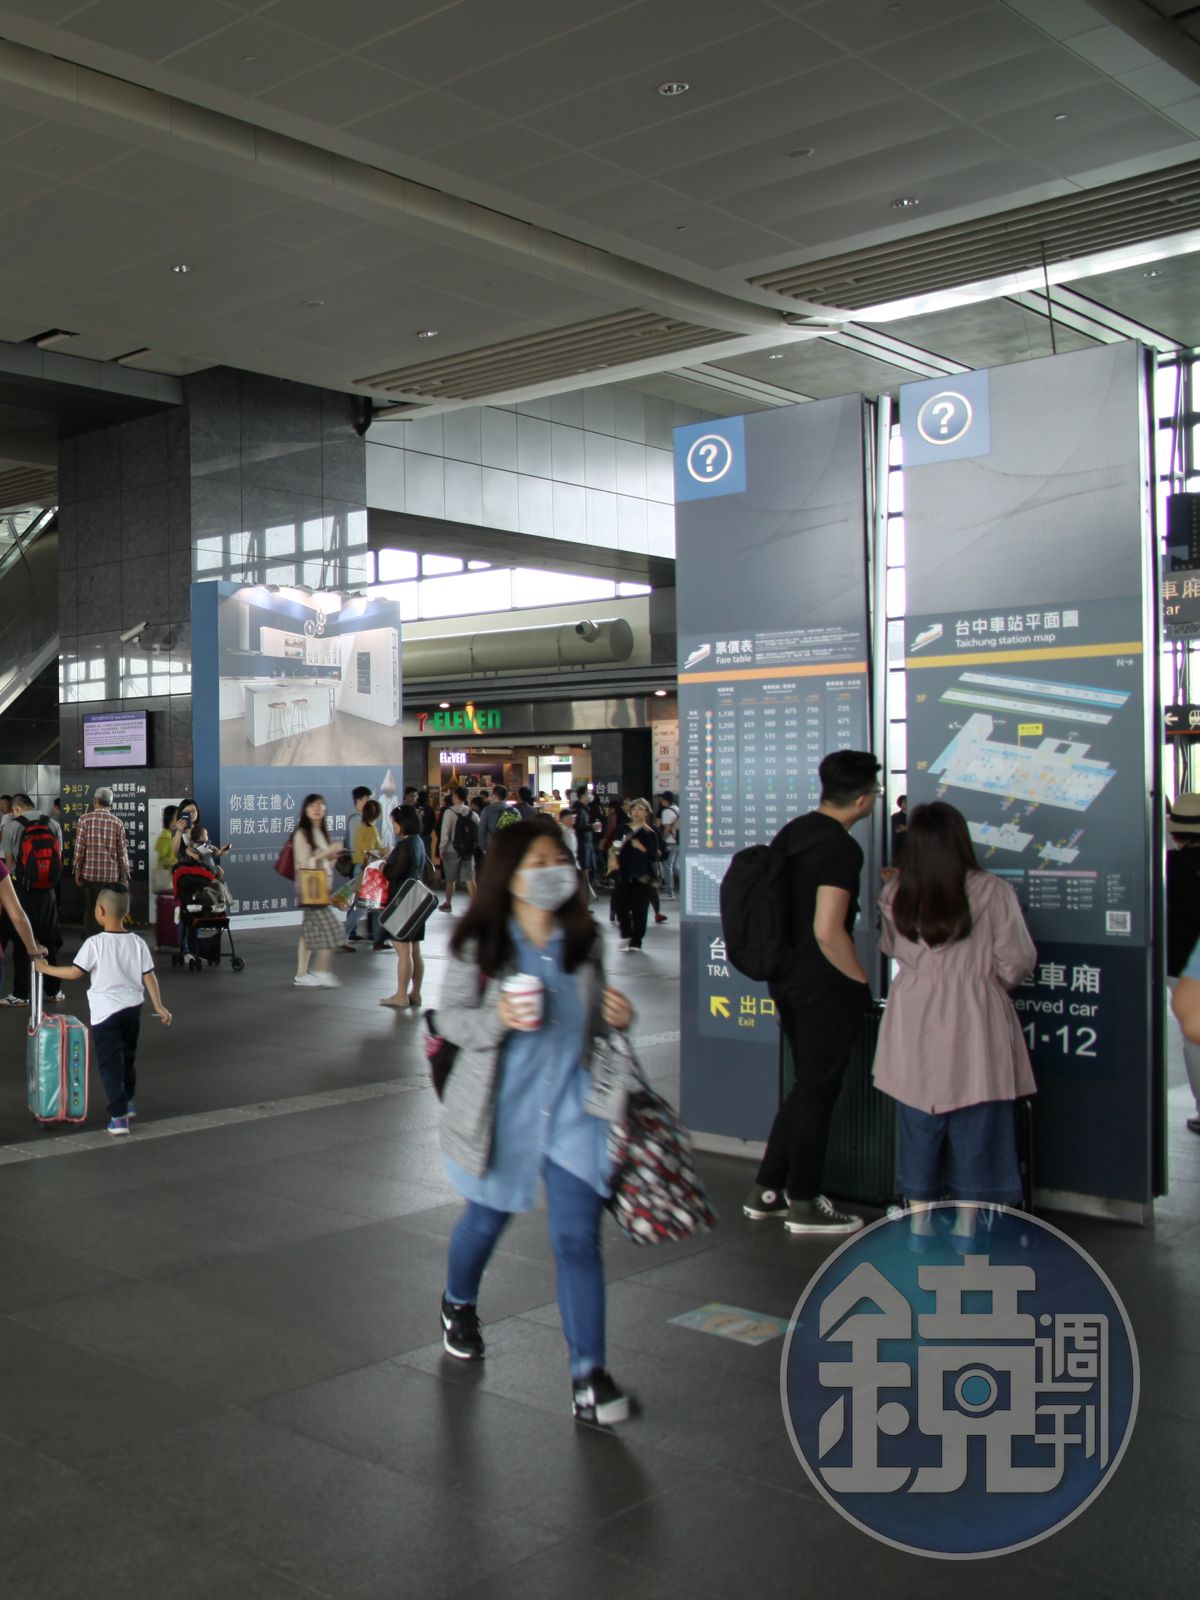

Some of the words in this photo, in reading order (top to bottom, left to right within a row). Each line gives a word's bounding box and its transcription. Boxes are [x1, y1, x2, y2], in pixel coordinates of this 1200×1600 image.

[1163, 603, 1181, 616] ar
[955, 610, 1079, 636] 台中車站平面圖
[715, 640, 753, 655] 票價表
[955, 637, 997, 648] Taichung
[998, 635, 1031, 645] station
[1033, 633, 1056, 643] map
[716, 656, 731, 665] Fare
[733, 655, 752, 664] table
[415, 709, 503, 732] 7-ELEVEN
[229, 794, 295, 811] 你還在擔心
[706, 964, 730, 977] TRA
[1021, 962, 1101, 994] 車廂
[740, 995, 776, 1016] 出口
[1069, 1003, 1098, 1017] car
[738, 1016, 755, 1027] Exit
